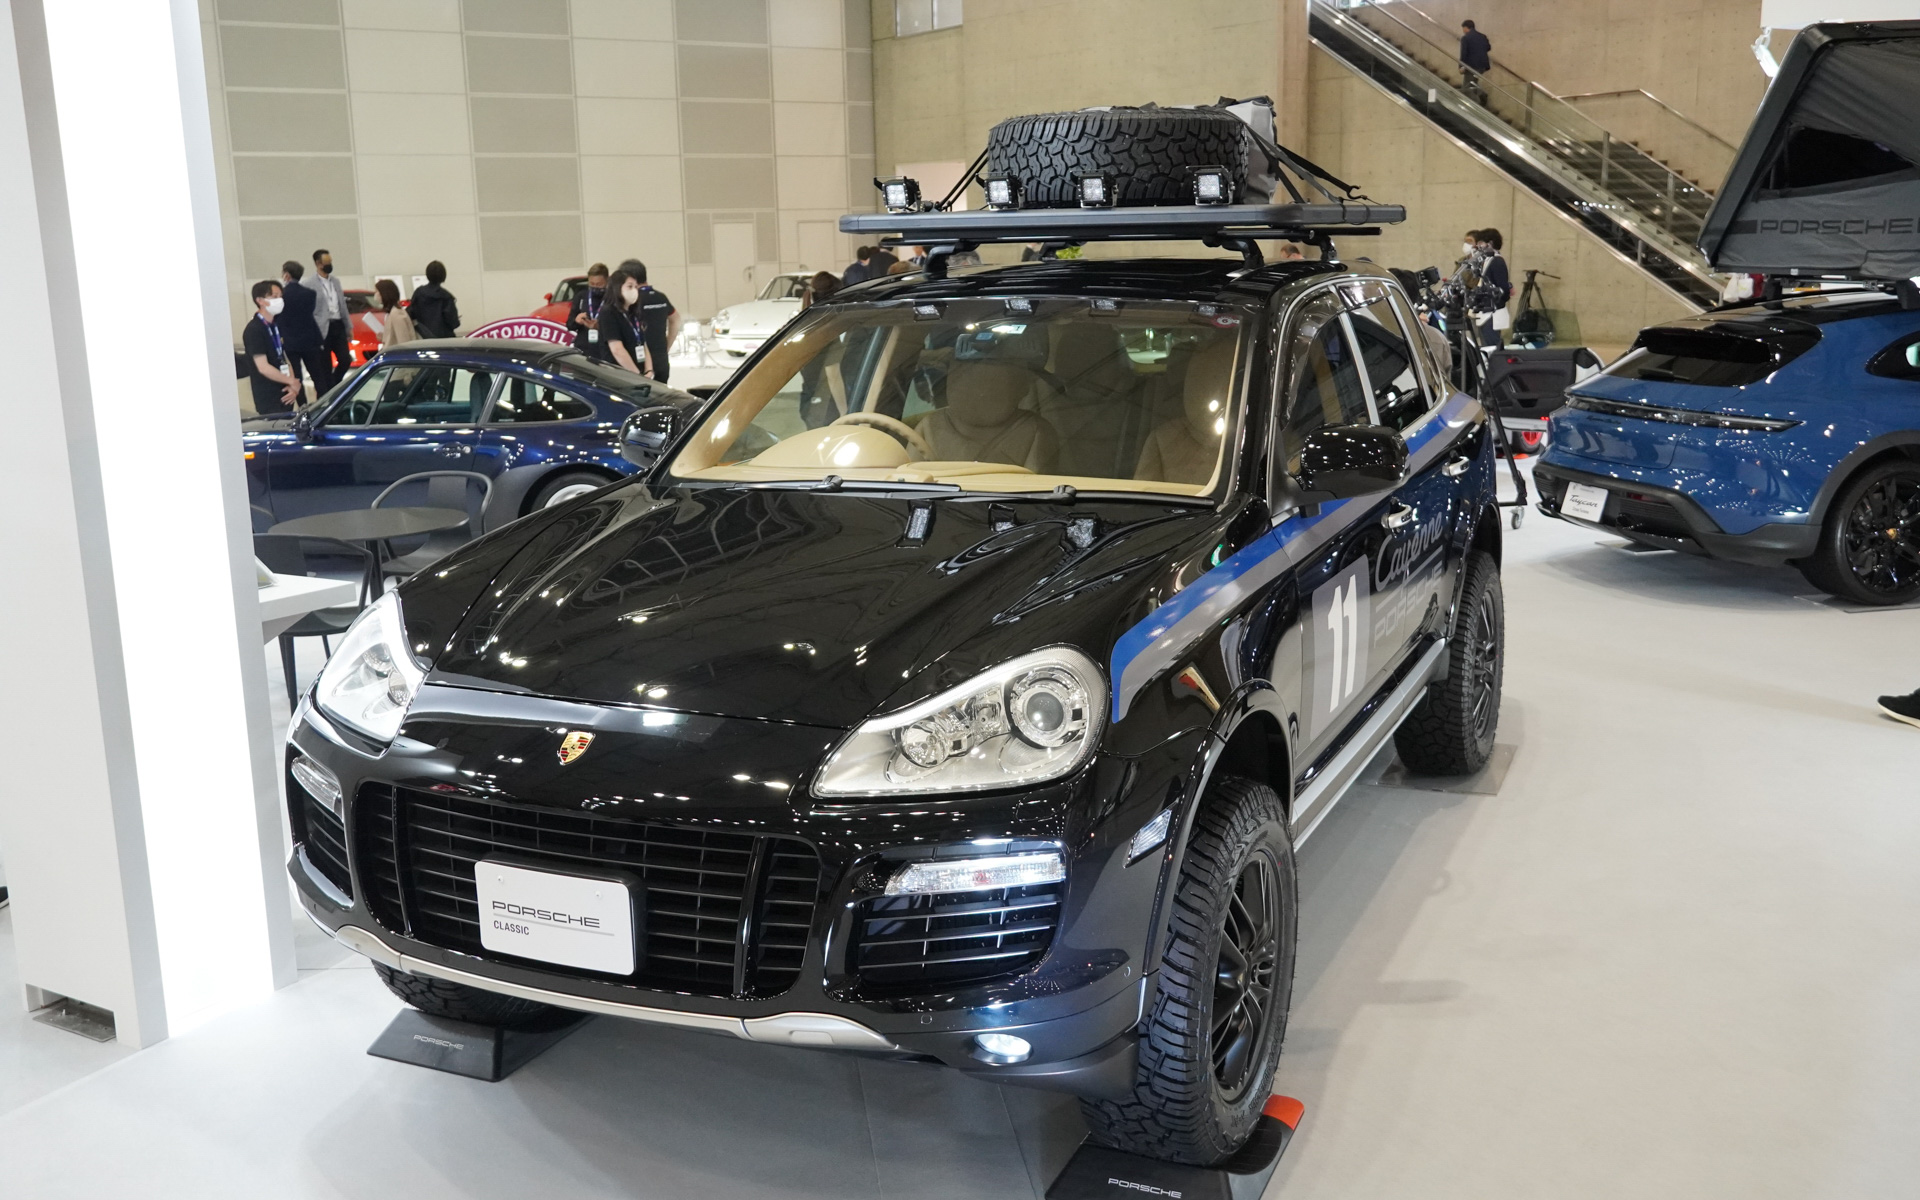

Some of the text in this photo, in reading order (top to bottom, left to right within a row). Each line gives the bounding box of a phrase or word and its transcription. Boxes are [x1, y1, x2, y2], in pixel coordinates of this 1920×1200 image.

[1760, 217, 1914, 235] PORSCHE
[1569, 494, 1599, 509] Taycan
[1375, 511, 1443, 597] Cayenne
[1374, 560, 1443, 649] PORSCHE
[1328, 574, 1357, 713] 11
[492, 900, 600, 929] PORSCHE
[493, 920, 530, 936] CLASSIC
[413, 1034, 465, 1050] PORSCHE
[1107, 1177, 1182, 1199] PORSCHE
